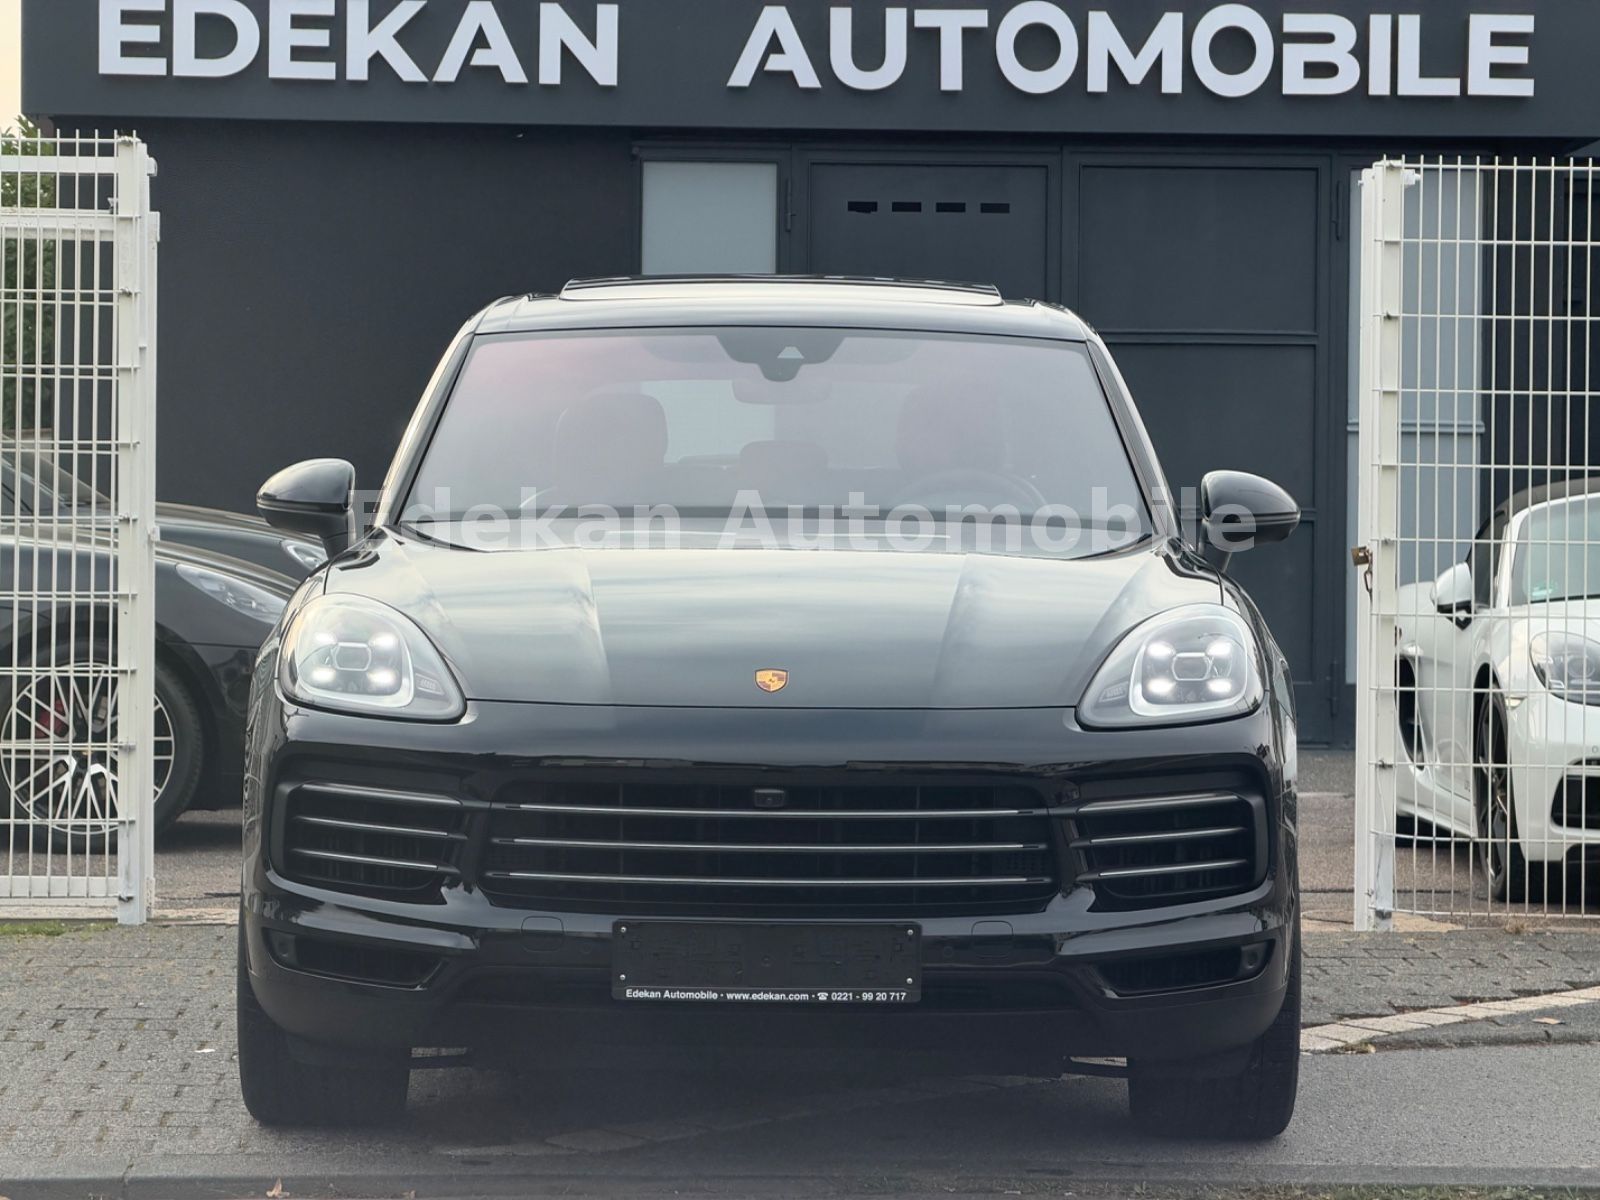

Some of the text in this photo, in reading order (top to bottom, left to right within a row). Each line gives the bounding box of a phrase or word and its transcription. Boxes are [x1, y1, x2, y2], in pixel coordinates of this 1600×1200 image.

[99, 0, 1535, 98] EDEKAN AUTOMOBILE
[626, 989, 660, 998] Edekan
[663, 990, 718, 1000] Automobile
[726, 991, 809, 1000] www.edekan.com
[831, 992, 853, 1000] 0221
[862, 992, 873, 1000] 99
[876, 992, 887, 1000] 20
[890, 992, 906, 1000] 717
